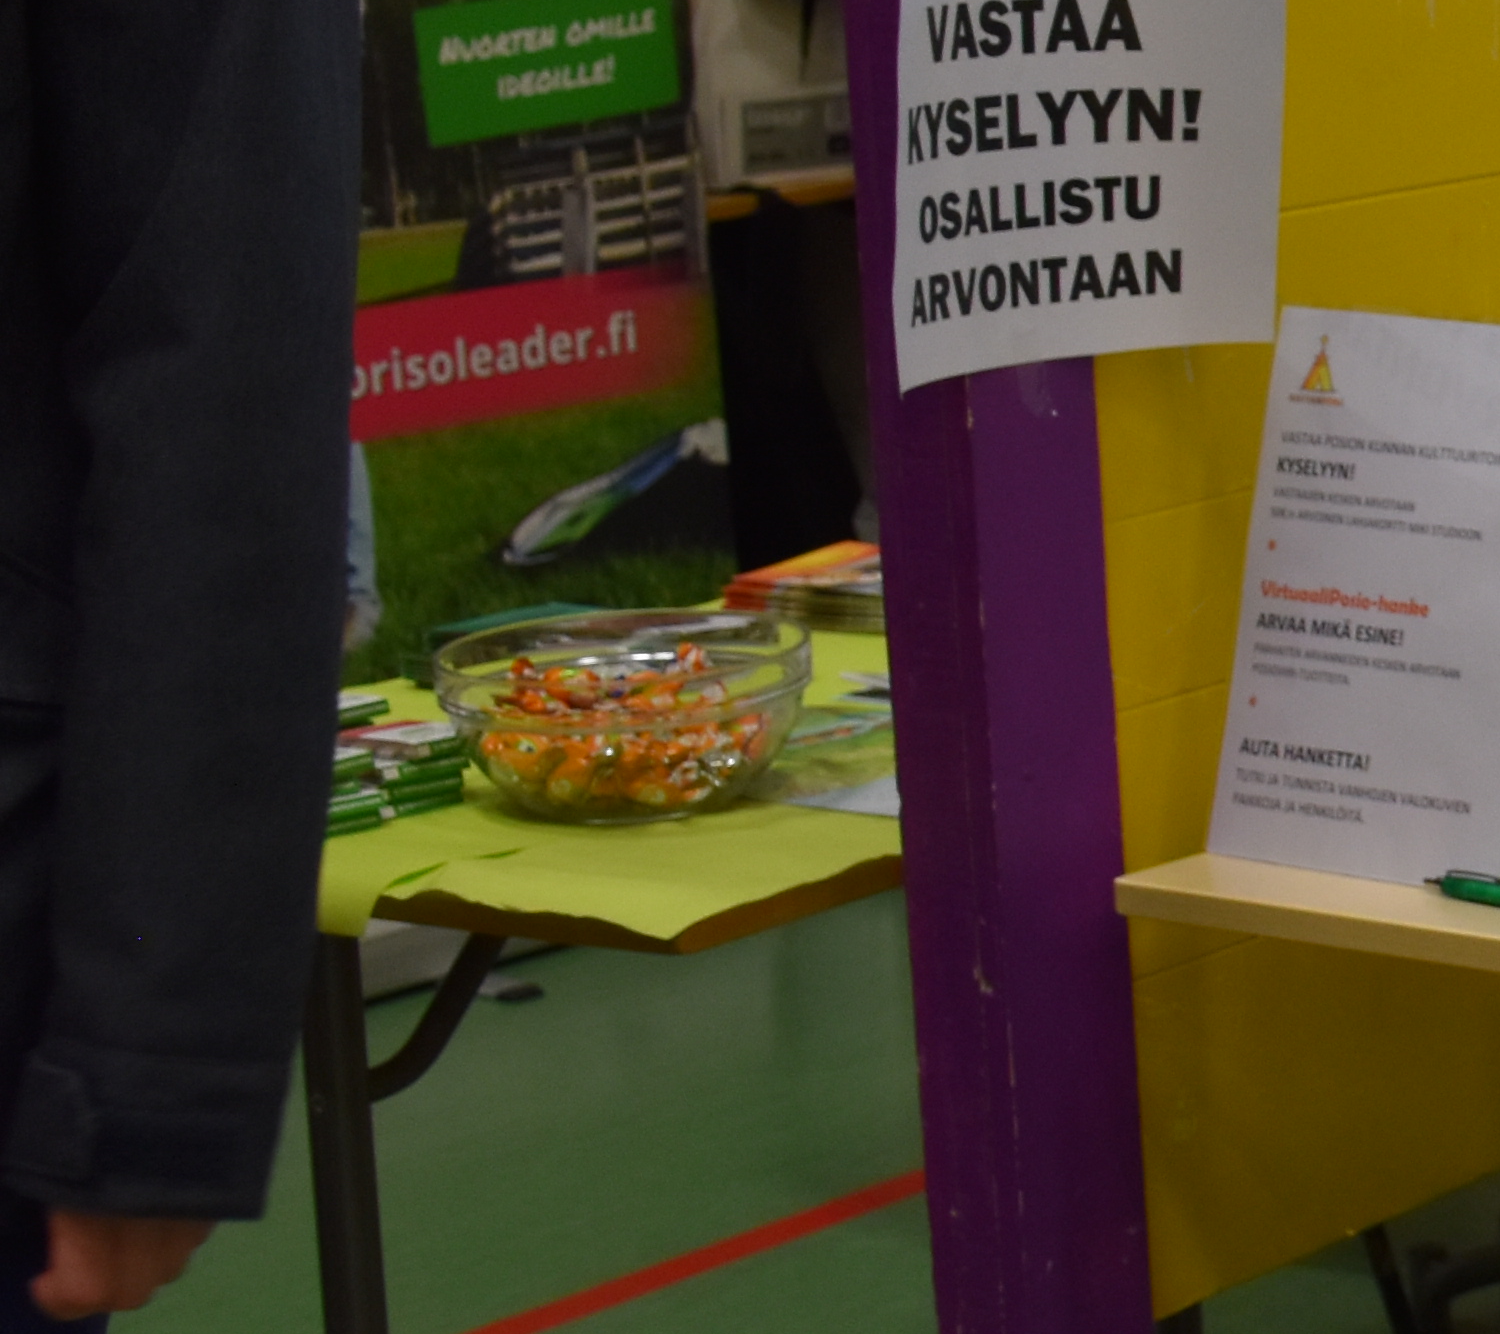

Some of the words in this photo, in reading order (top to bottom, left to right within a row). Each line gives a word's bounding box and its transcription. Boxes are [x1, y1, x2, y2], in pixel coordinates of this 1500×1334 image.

[907, 88, 1202, 165] KYSELYYN!
[919, 175, 1161, 243] OSALLISTU
[911, 249, 1182, 327] ARVONTAAN
[1276, 456, 1356, 481] KYSELYYN!
[1256, 612, 1306, 634] ARVAA
[1355, 624, 1405, 646] ESINE!
[1239, 737, 1279, 759] AUTA
[1283, 744, 1371, 772] HANKETTA!
